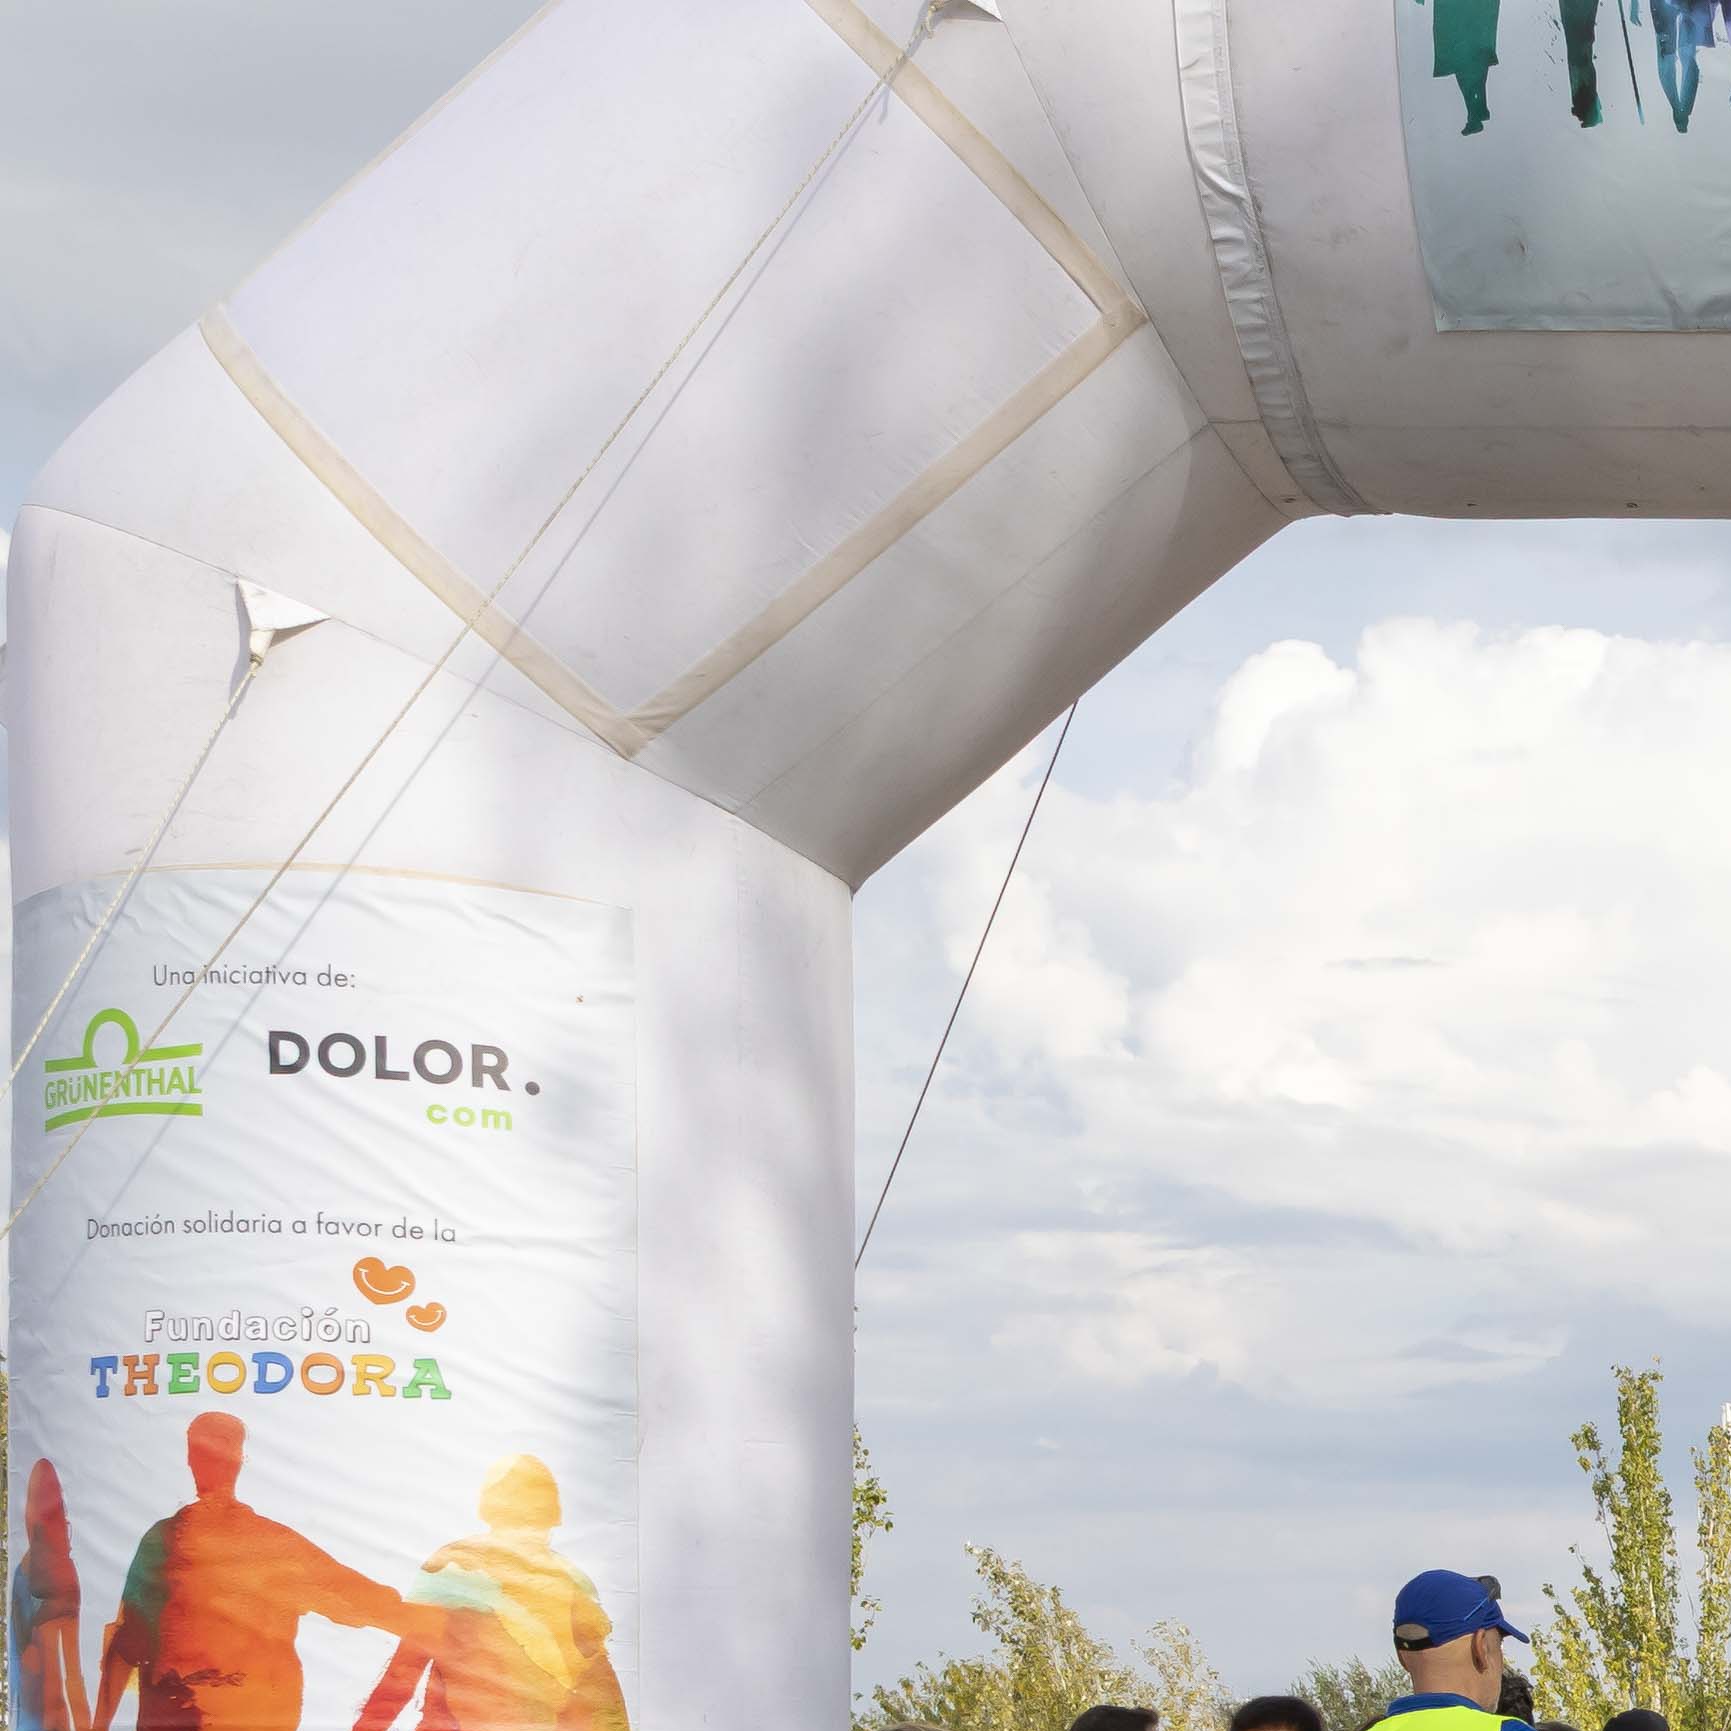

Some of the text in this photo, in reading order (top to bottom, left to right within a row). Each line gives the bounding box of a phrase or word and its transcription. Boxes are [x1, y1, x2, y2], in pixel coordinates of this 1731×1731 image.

[153, 963, 356, 989] Una iniciativa de:
[267, 1030, 541, 1096] DOLOR.
[45, 1064, 203, 1110] GRÜNENTHAL
[426, 1103, 514, 1131] com
[86, 1211, 457, 1244] Donación solidaria a favor de la
[144, 1307, 371, 1344] Fundación
[90, 1350, 452, 1400] THEODORA
